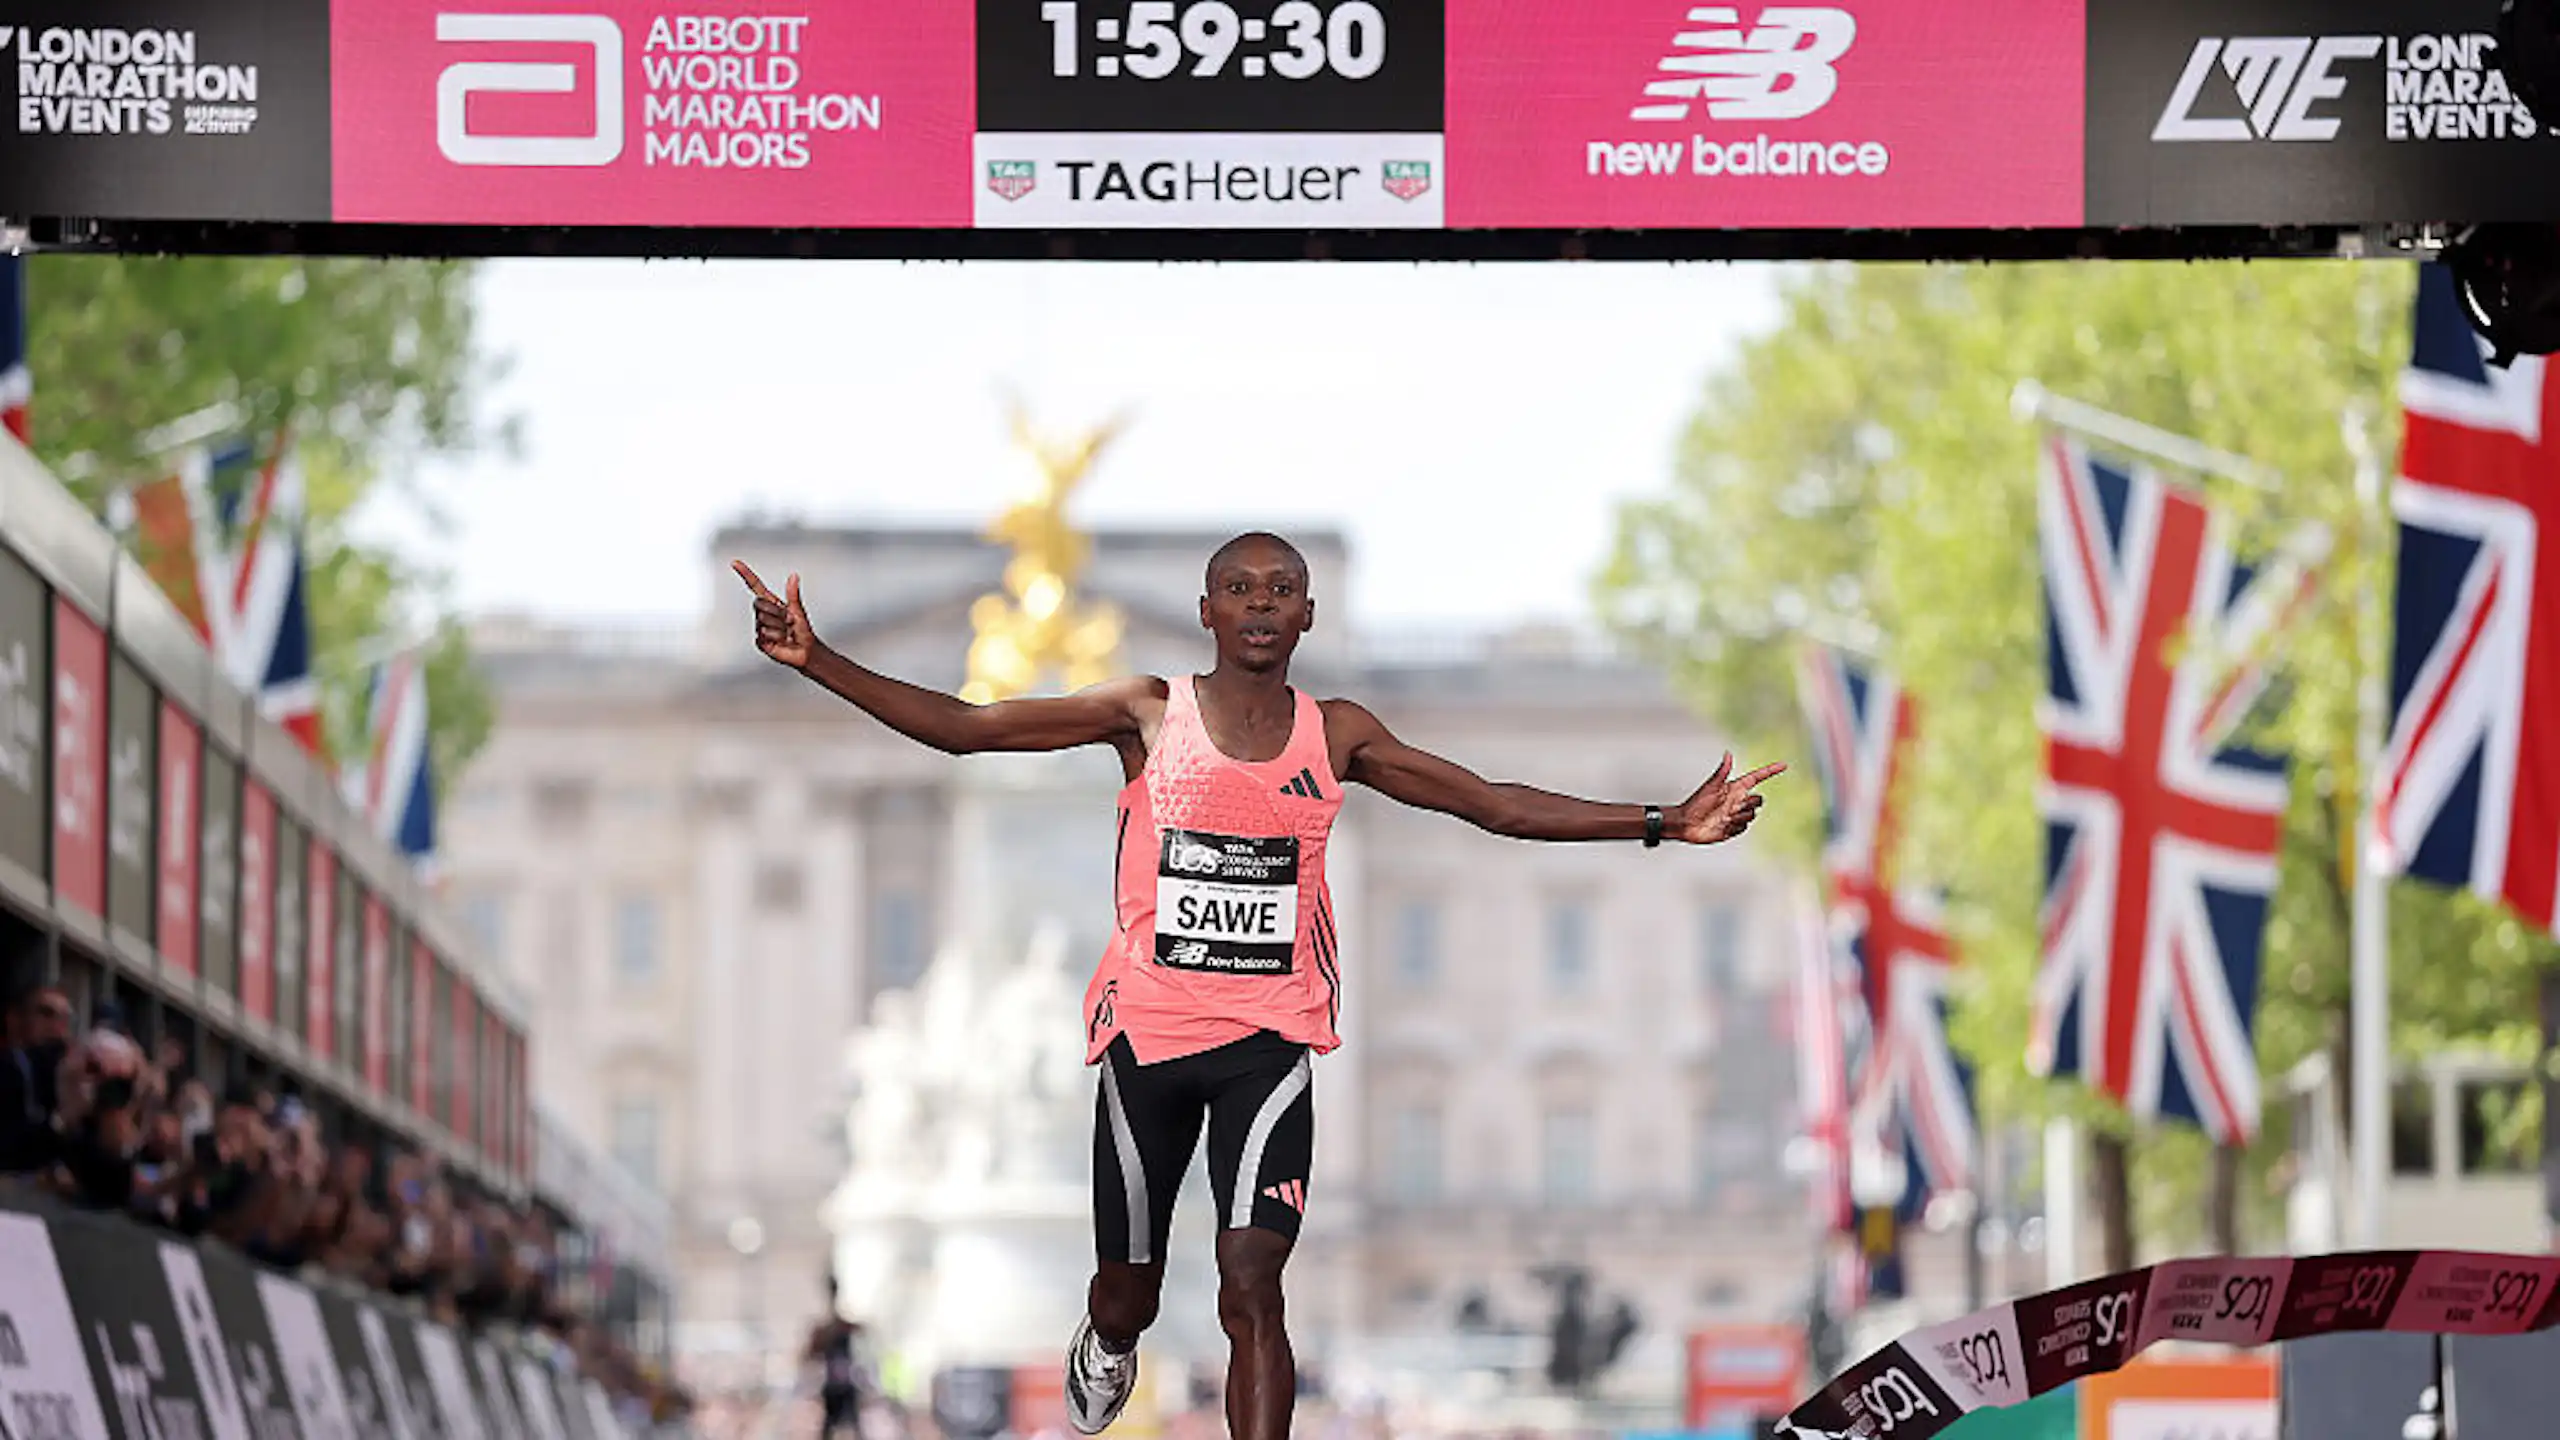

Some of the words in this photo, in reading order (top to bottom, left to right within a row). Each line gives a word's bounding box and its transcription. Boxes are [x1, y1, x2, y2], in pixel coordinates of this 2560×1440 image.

[18, 27, 195, 64] LONDON
[643, 15, 809, 53] ABBOTT
[1041, 1, 1386, 78] 1:59:30
[19, 62, 258, 101] MARATHON
[642, 55, 799, 91] WORLD
[2386, 68, 2512, 103] MARA
[19, 98, 171, 133] EVENTS
[644, 93, 881, 130] MARATHON
[2386, 102, 2537, 139] EVENTS
[645, 130, 811, 168] MAJORS
[1586, 140, 1684, 176] new
[1692, 133, 1891, 176] balance
[1177, 895, 1278, 935] SAWE
[1233, 957, 1281, 970] balance
